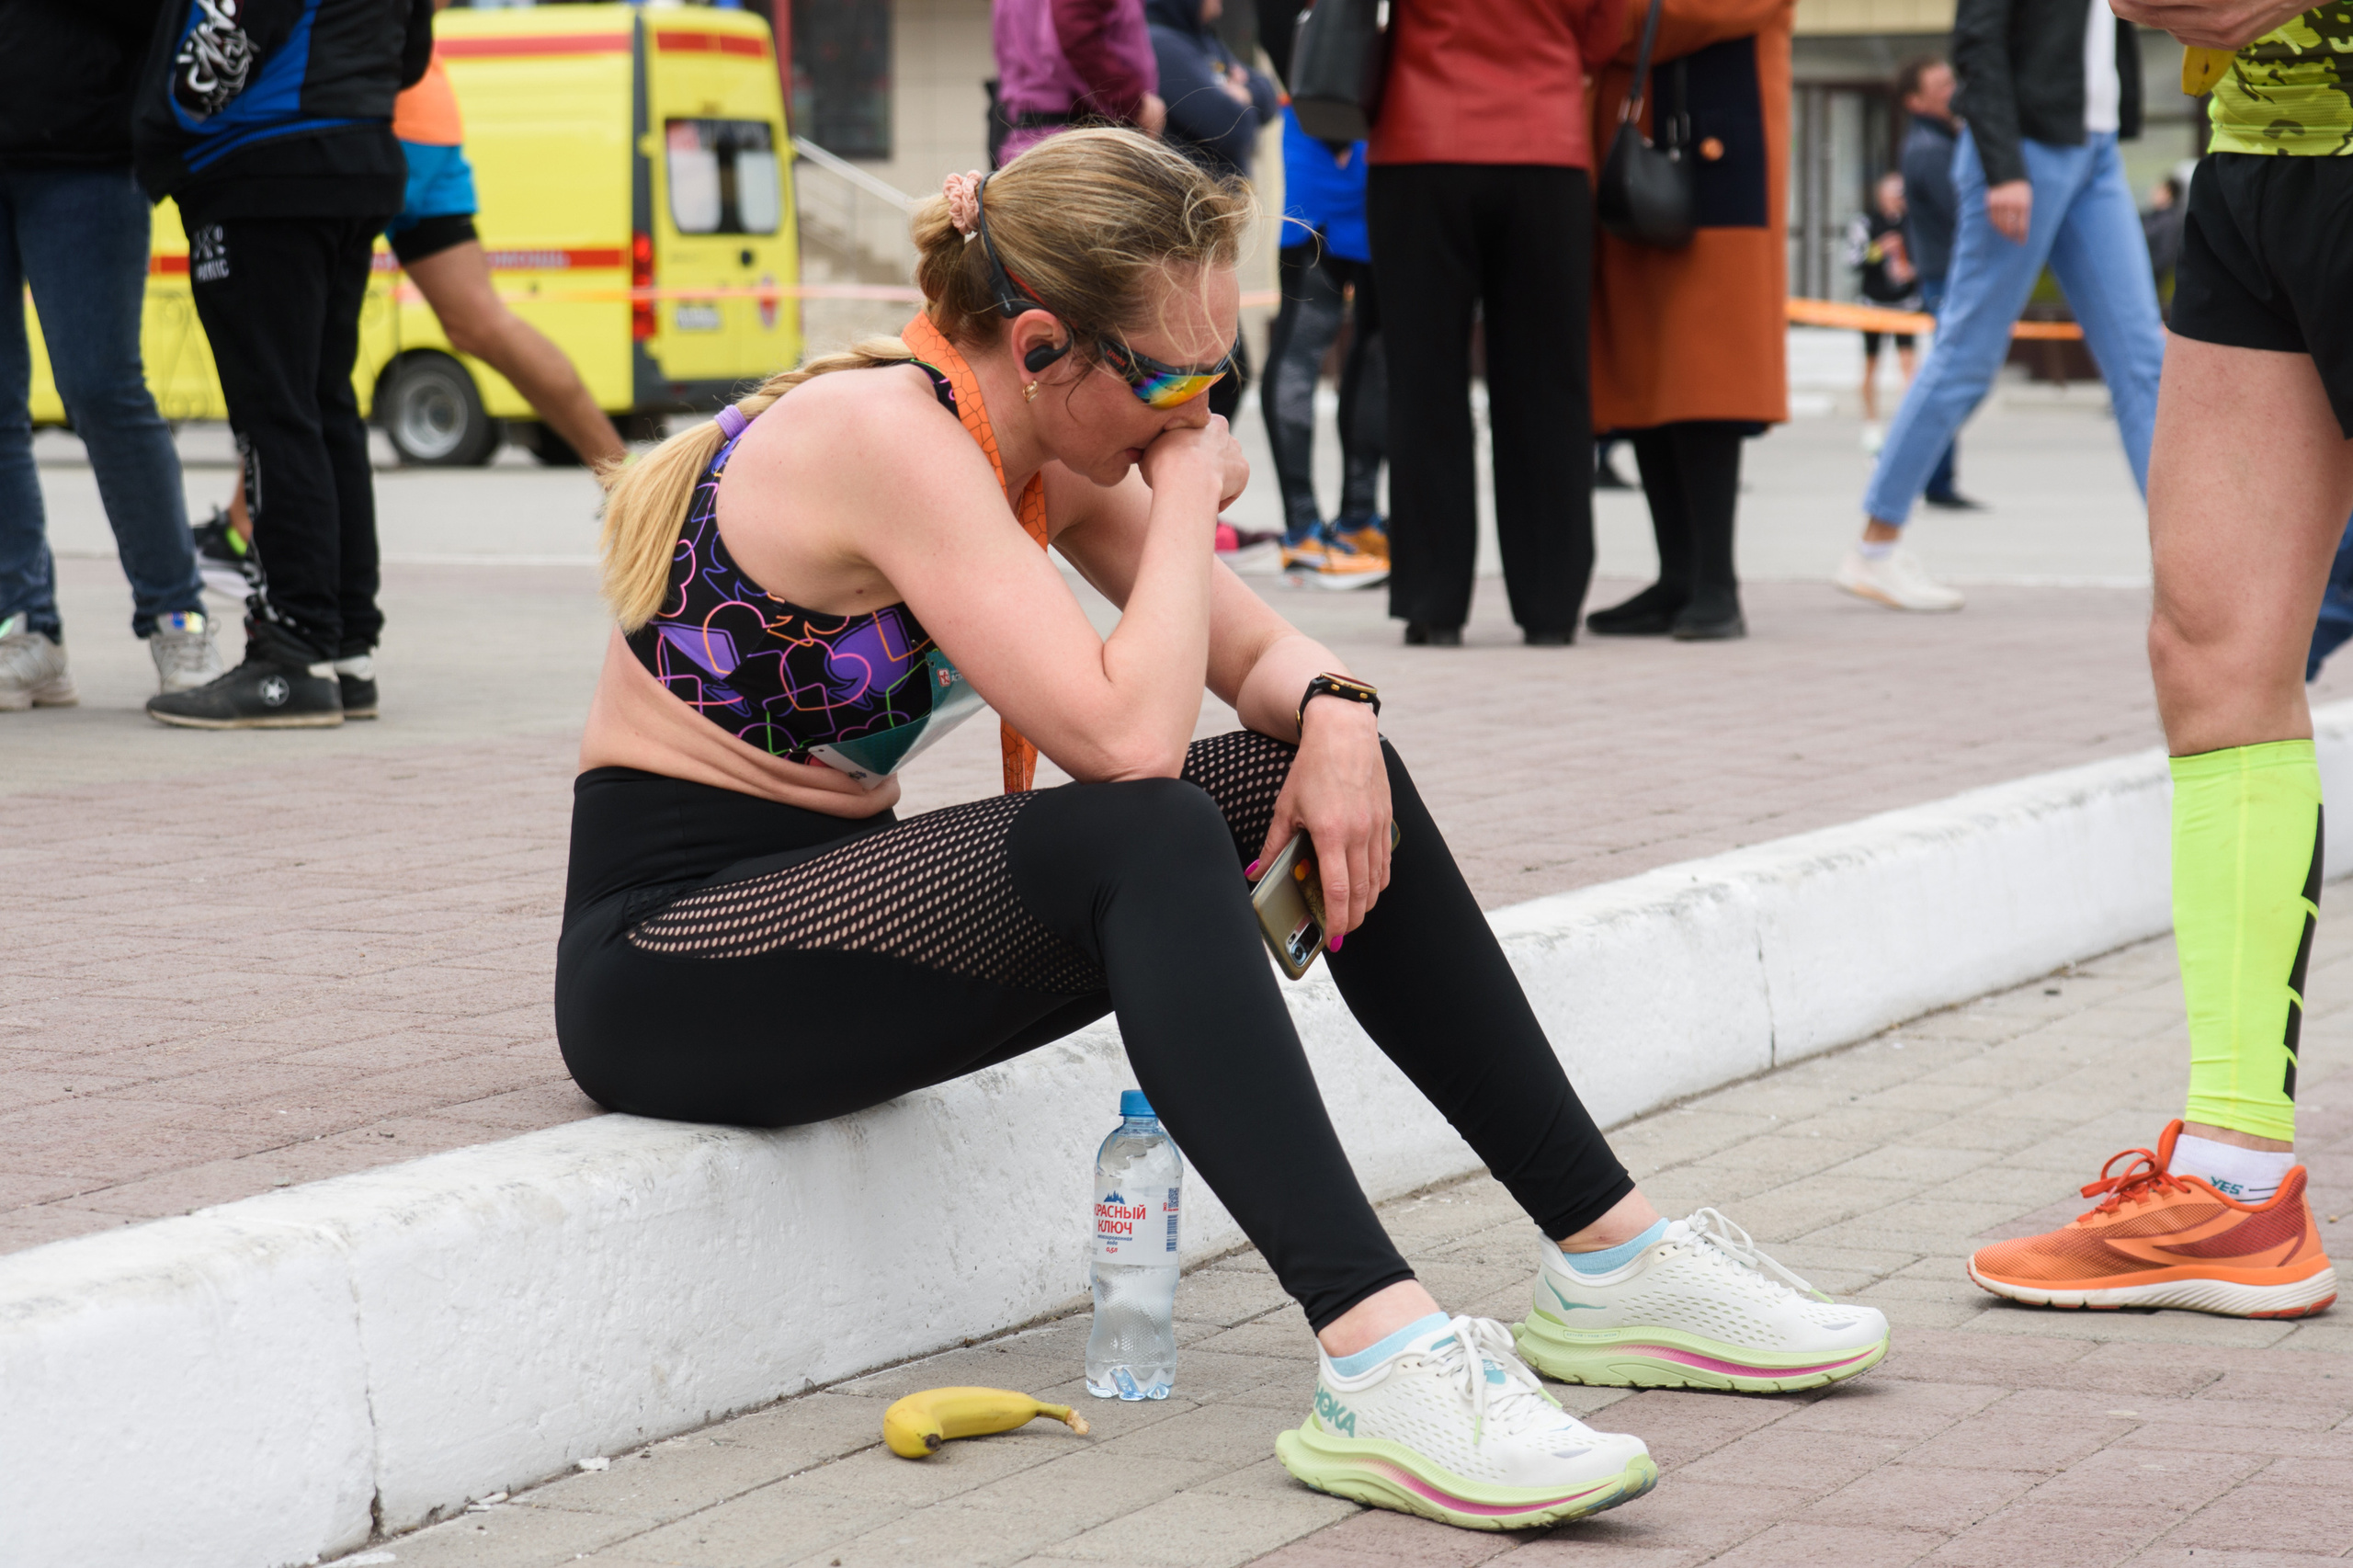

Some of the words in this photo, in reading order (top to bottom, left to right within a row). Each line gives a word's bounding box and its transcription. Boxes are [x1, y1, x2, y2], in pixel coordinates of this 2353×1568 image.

[2211, 1176, 2244, 1195] YES
[1098, 1219, 1132, 1234] КЛЮЧ
[1314, 1381, 1356, 1438] HOKA
